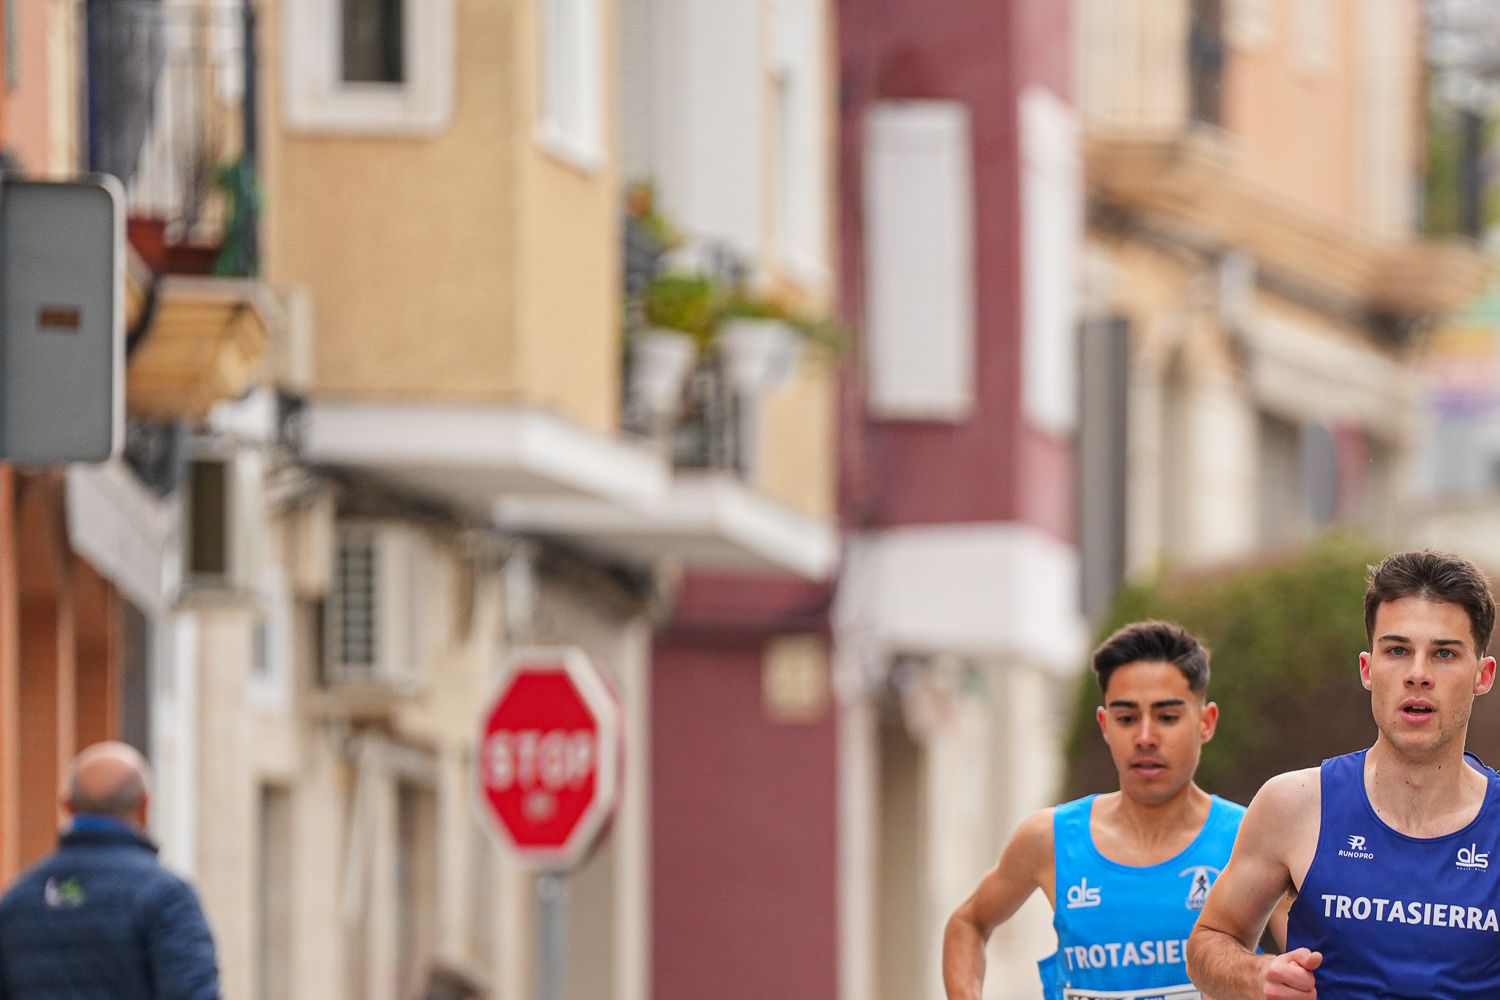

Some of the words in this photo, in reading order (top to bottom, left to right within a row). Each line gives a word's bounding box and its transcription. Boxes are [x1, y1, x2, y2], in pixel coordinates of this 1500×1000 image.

[487, 728, 594, 791] STOP
[1338, 849, 1375, 860] RUNOPRO
[1321, 894, 1500, 933] TROTASIERRA
